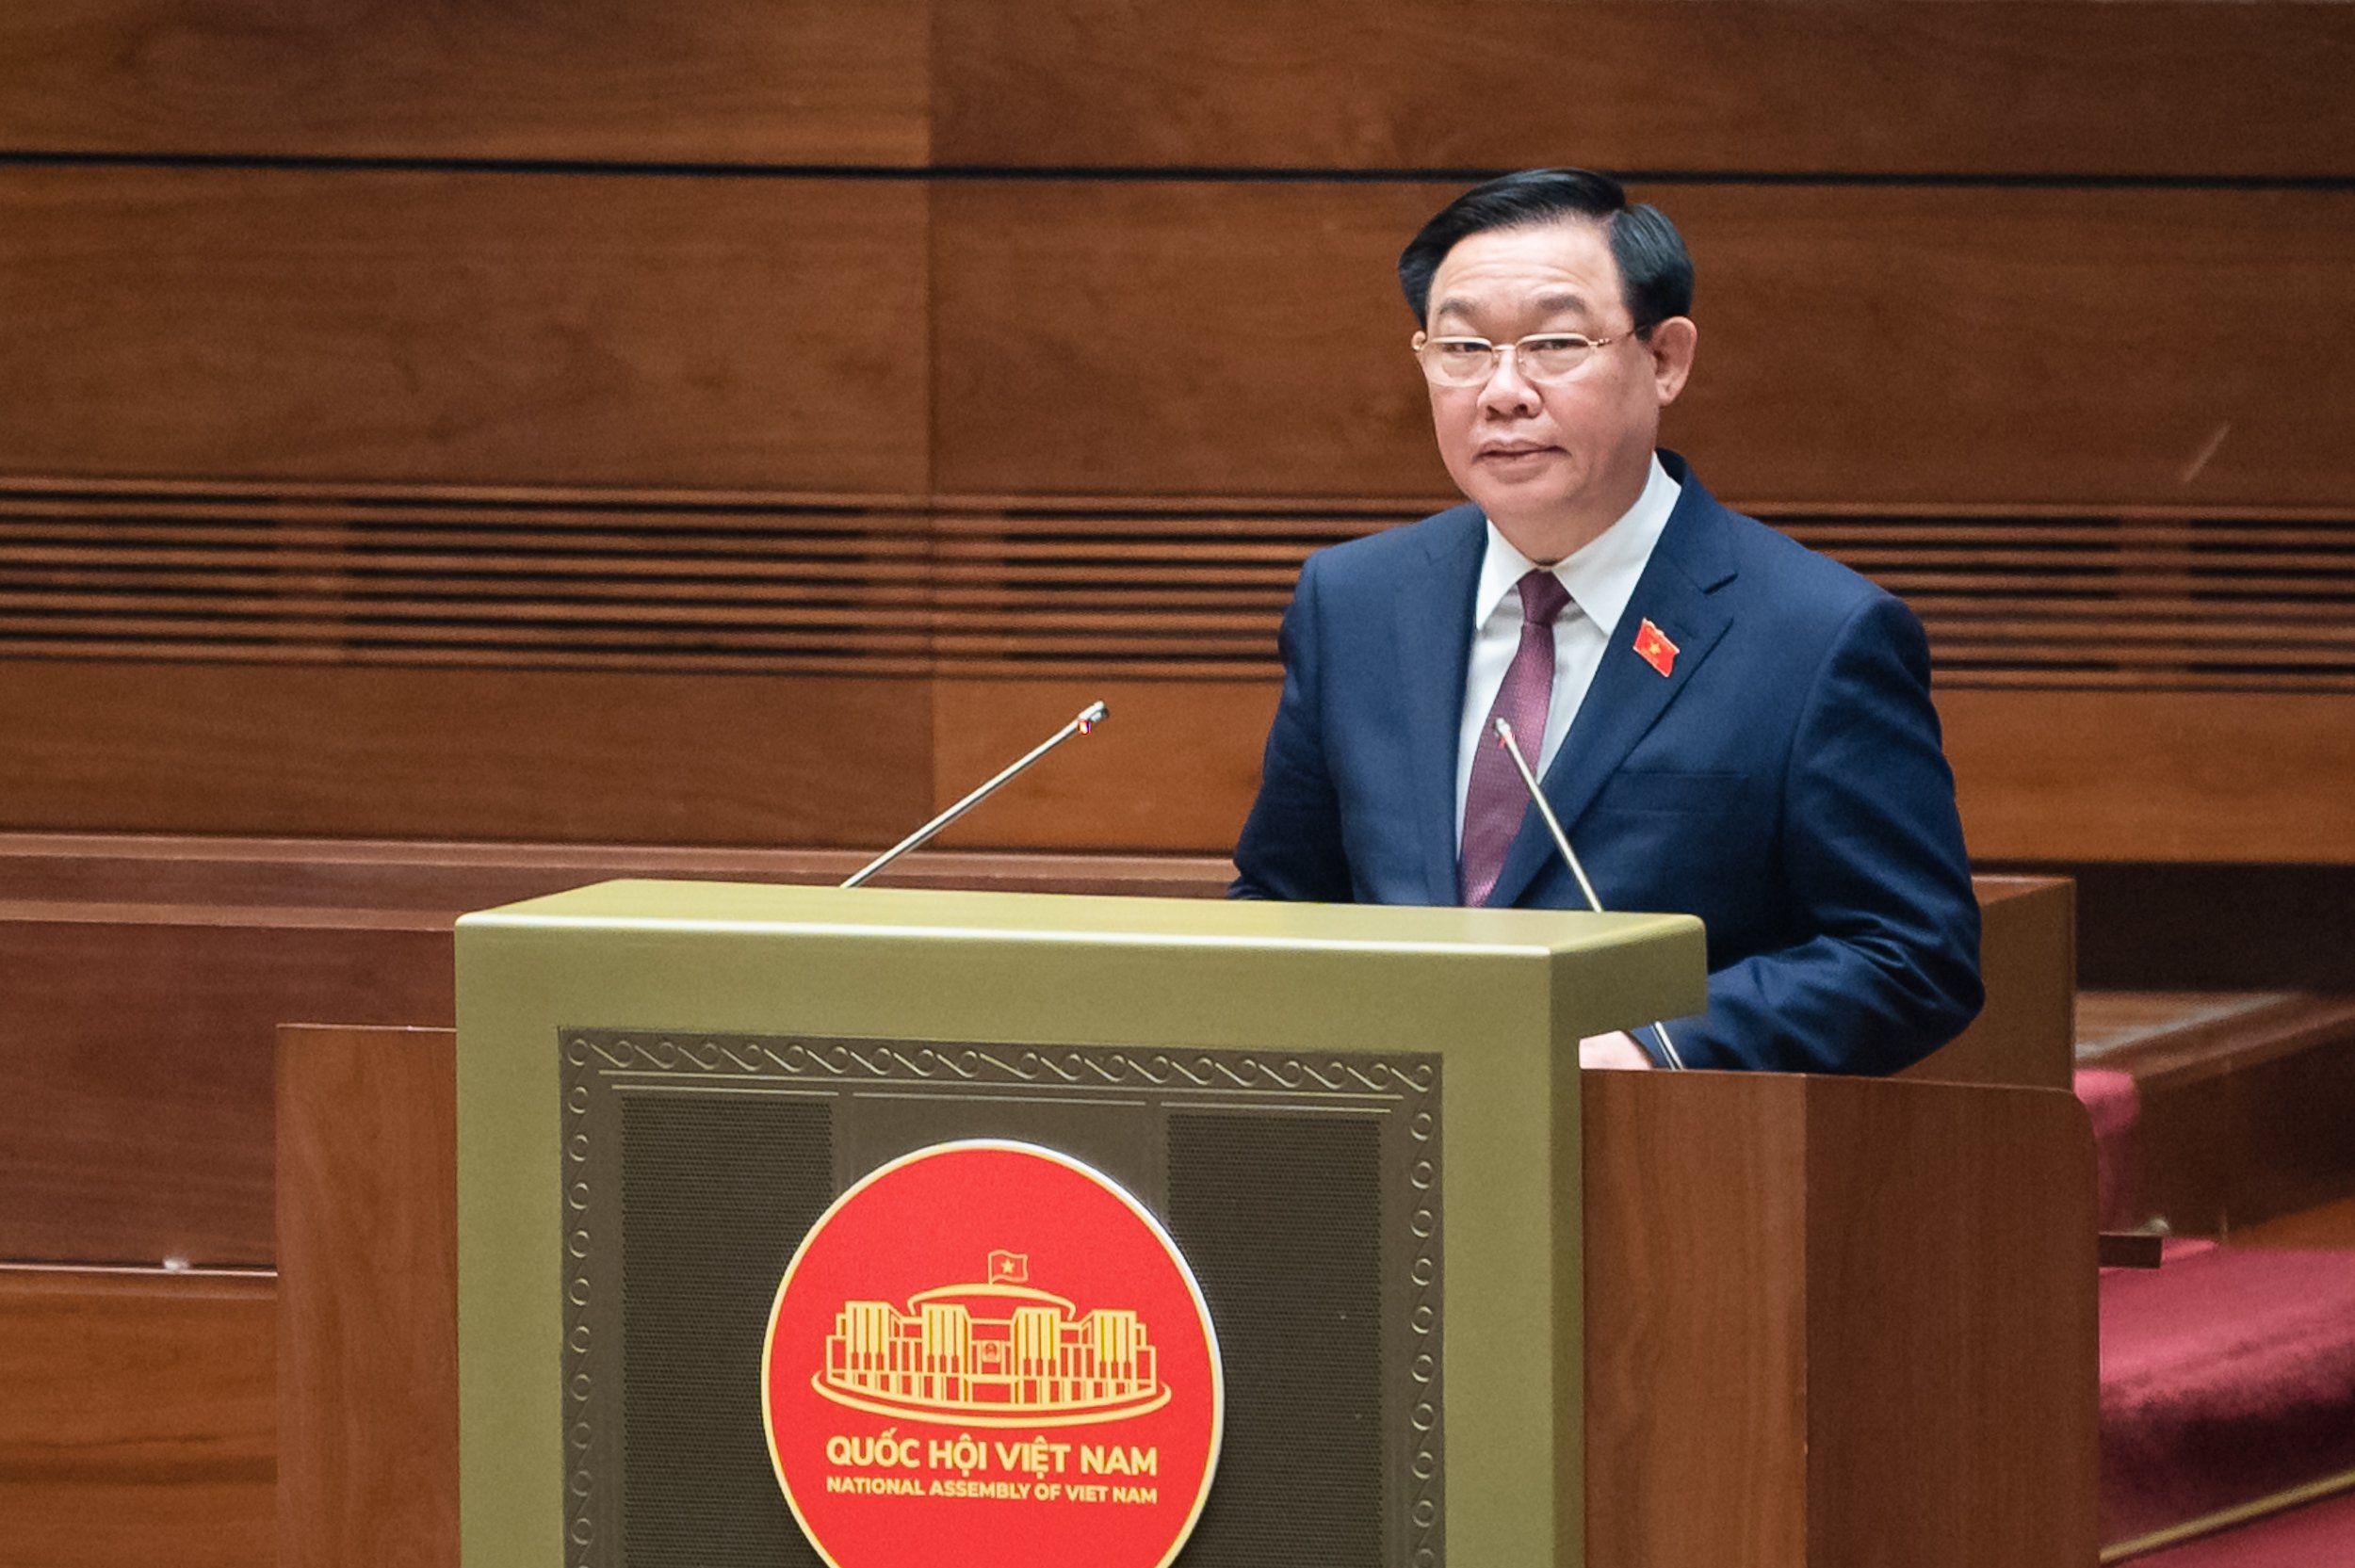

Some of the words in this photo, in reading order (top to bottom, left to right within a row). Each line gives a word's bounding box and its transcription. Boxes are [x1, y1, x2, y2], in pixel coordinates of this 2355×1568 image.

[825, 1427, 920, 1468] QUỐC
[929, 1432, 987, 1477] HỘI
[995, 1435, 1071, 1479] VIỆT
[1080, 1445, 1158, 1476] NAM
[826, 1477, 926, 1495] NATIONAL
[929, 1479, 1031, 1499] ASSEMBLY
[1034, 1483, 1061, 1501] OF
[1065, 1484, 1109, 1502] VIET
[1113, 1486, 1158, 1504] NAM
